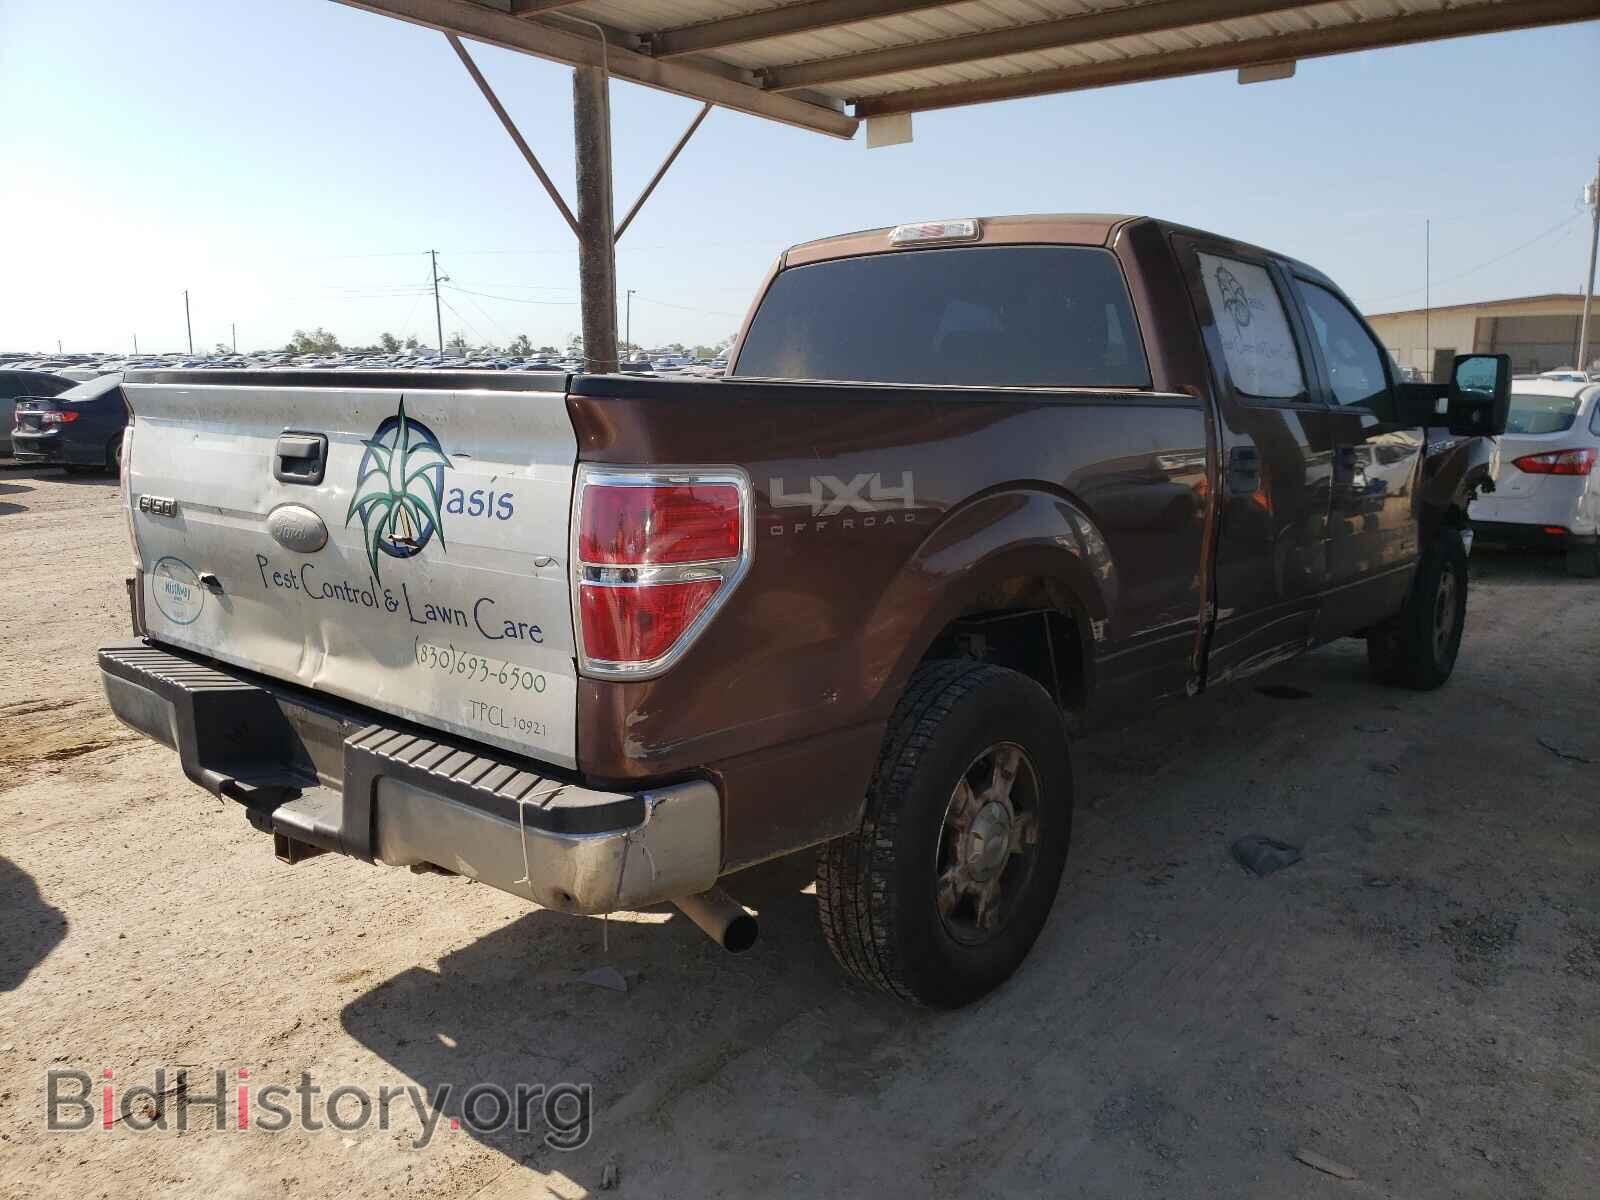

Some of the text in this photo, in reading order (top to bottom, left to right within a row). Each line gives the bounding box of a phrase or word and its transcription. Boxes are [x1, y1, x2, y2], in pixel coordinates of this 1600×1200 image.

[770, 513, 916, 536] OFF ROAD
[256, 554, 544, 643] Pest Control & Lawn Care
[469, 700, 546, 737] TPCL 10921
